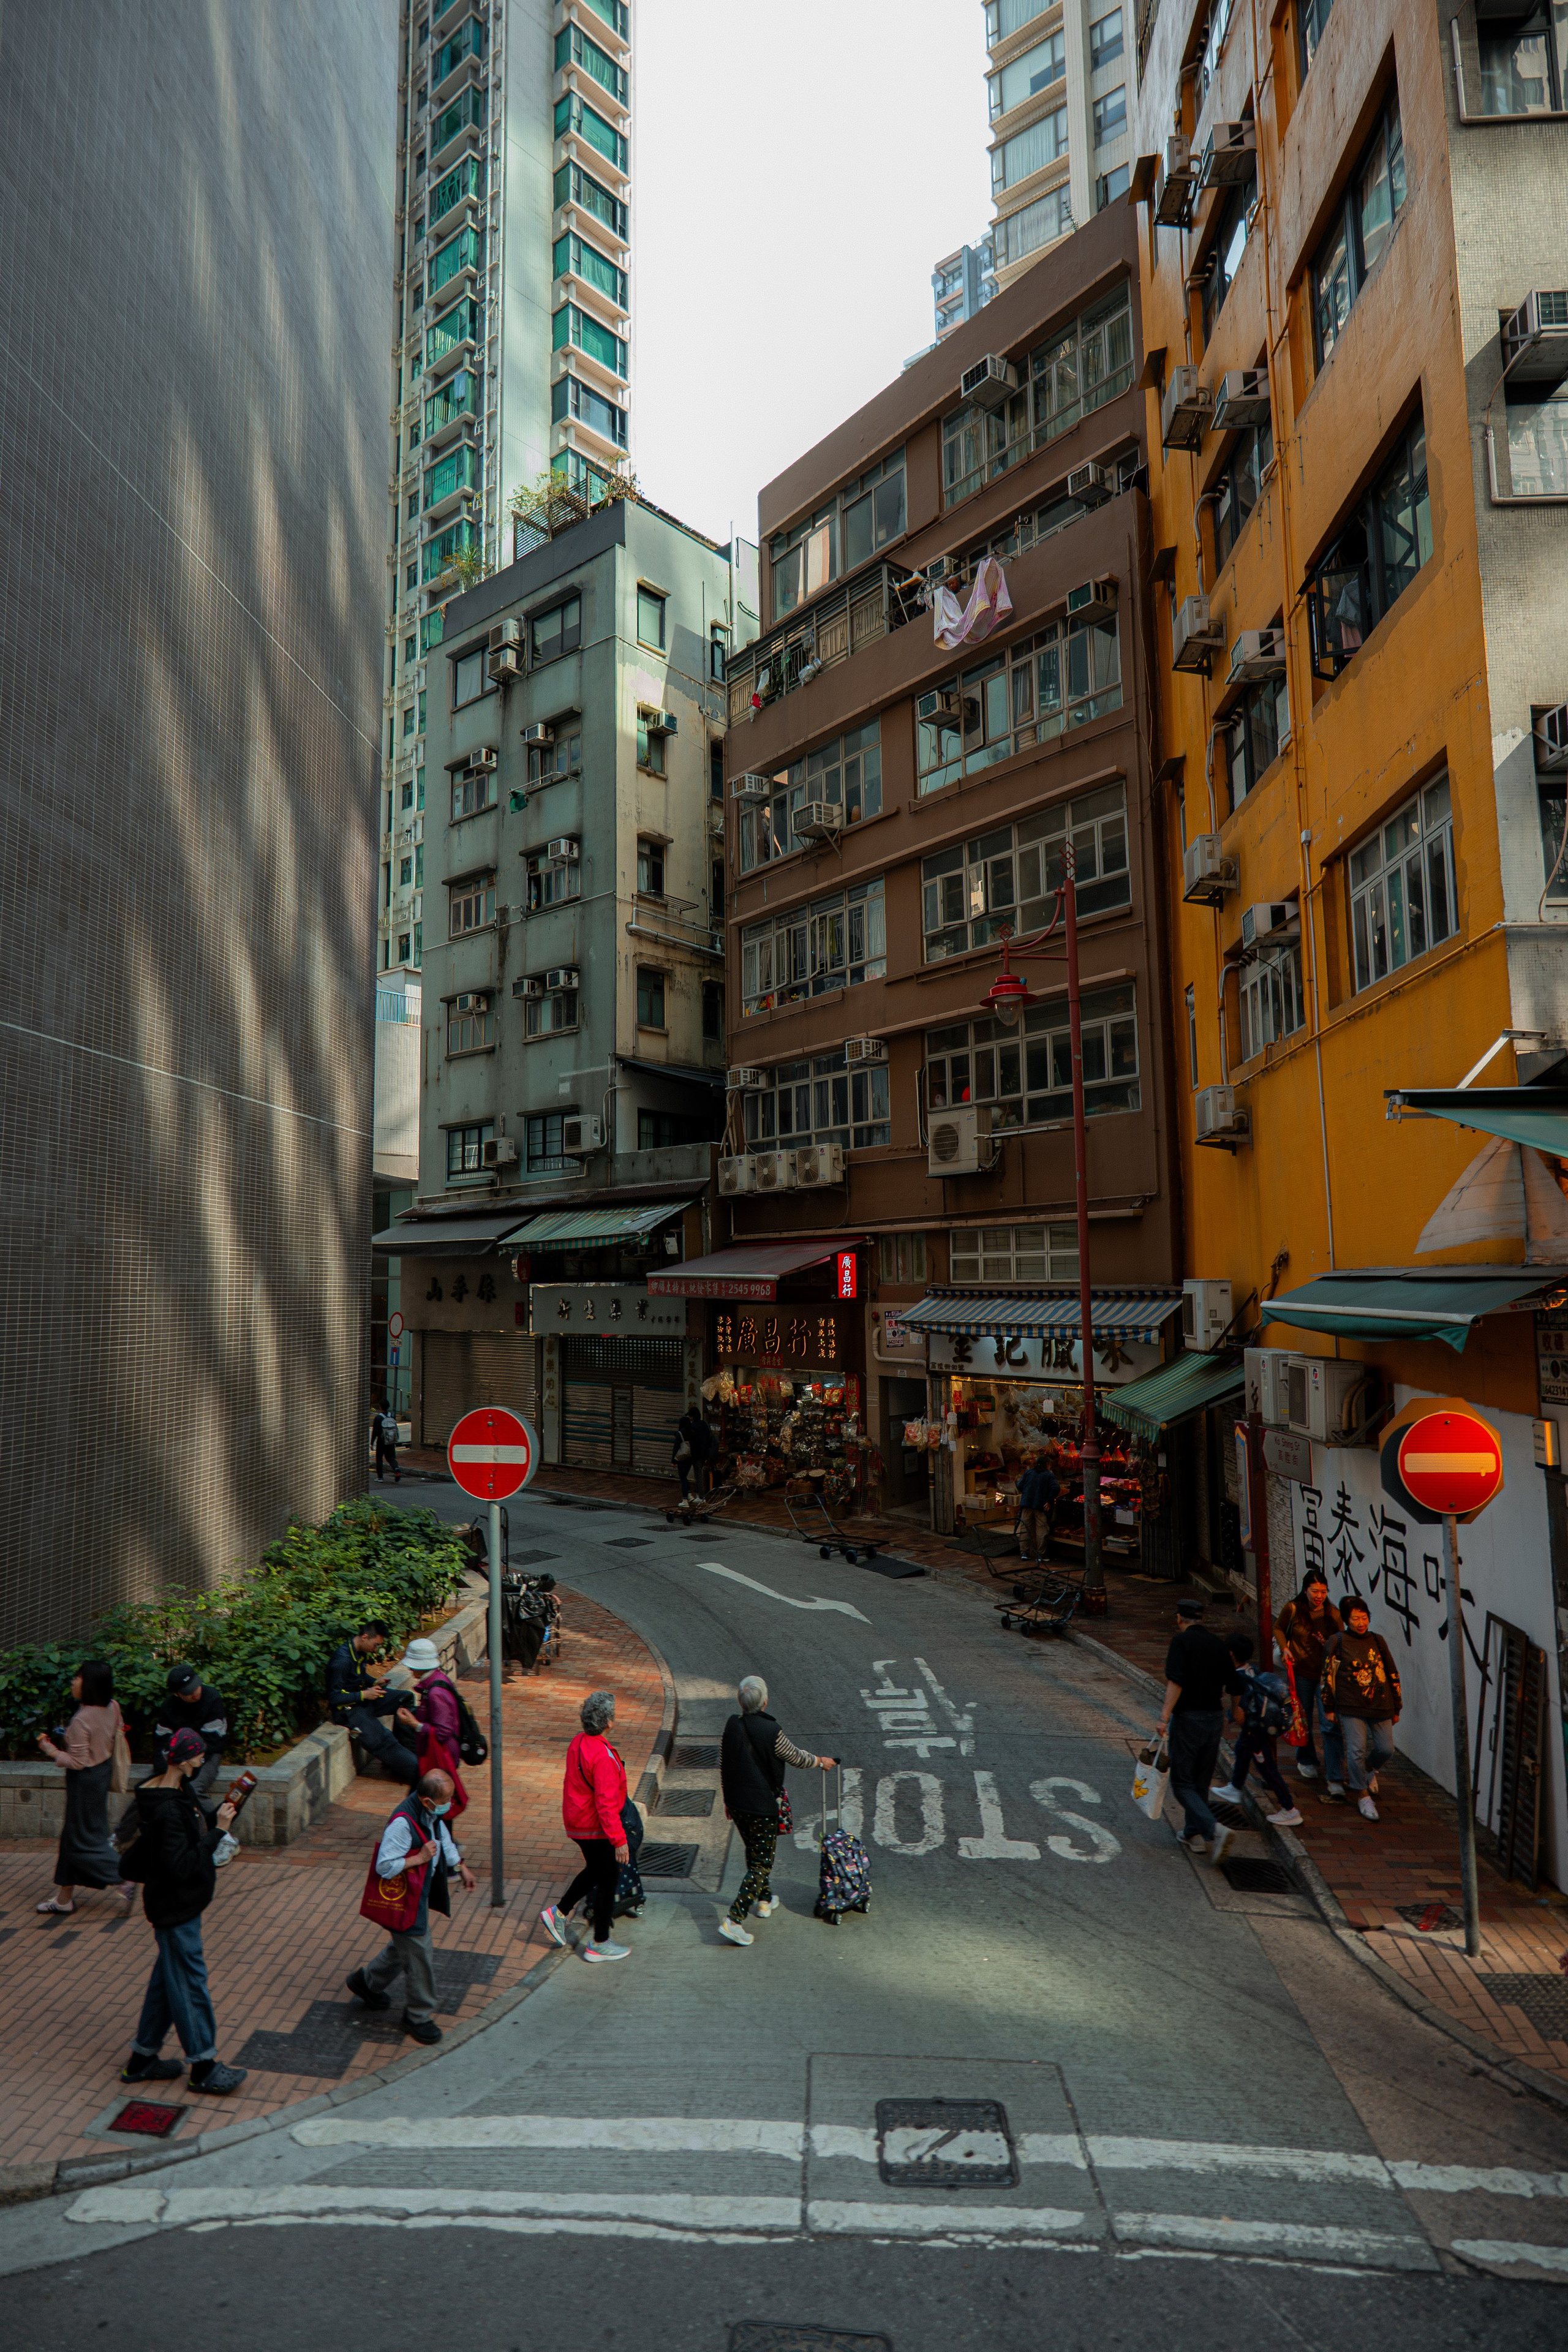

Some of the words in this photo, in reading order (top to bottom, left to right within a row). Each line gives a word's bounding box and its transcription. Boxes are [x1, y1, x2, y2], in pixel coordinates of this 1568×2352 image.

[728, 1283, 748, 1295] 2545
[750, 1284, 771, 1296] 9968
[841, 1255, 853, 1297] 廣昌行
[737, 1316, 812, 1357] 廣昌行
[1274, 1436, 1280, 1446] Ko
[1281, 1438, 1294, 1452] Shing
[859, 1657, 978, 1758] 停
[793, 1768, 1122, 1863] STOP
